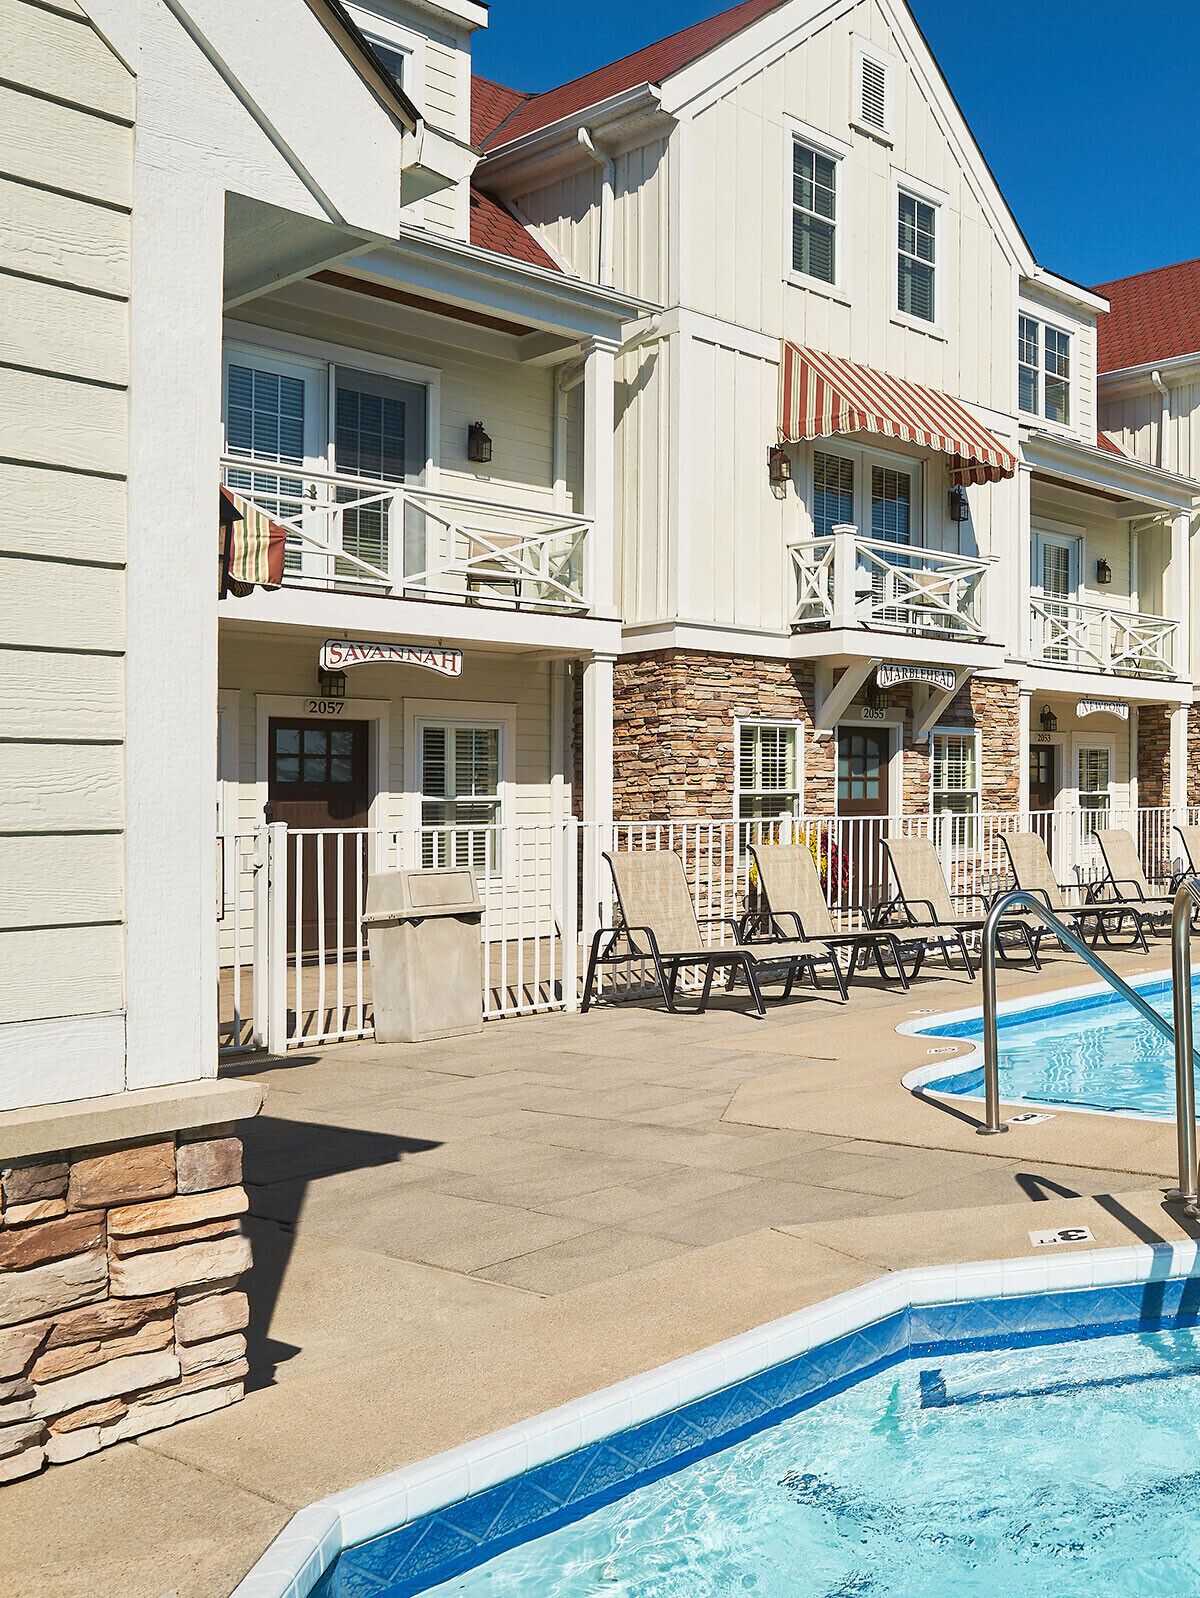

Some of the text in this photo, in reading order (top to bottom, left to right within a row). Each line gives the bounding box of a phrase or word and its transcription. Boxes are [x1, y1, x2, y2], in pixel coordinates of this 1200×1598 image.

[329, 642, 459, 673] SAVANNAH
[882, 665, 955, 689] MARBLEHEAD
[308, 700, 345, 715] 2057
[863, 707, 885, 719] 2055
[1081, 700, 1127, 717] NEWPORT
[1057, 1229, 1088, 1241] 3
